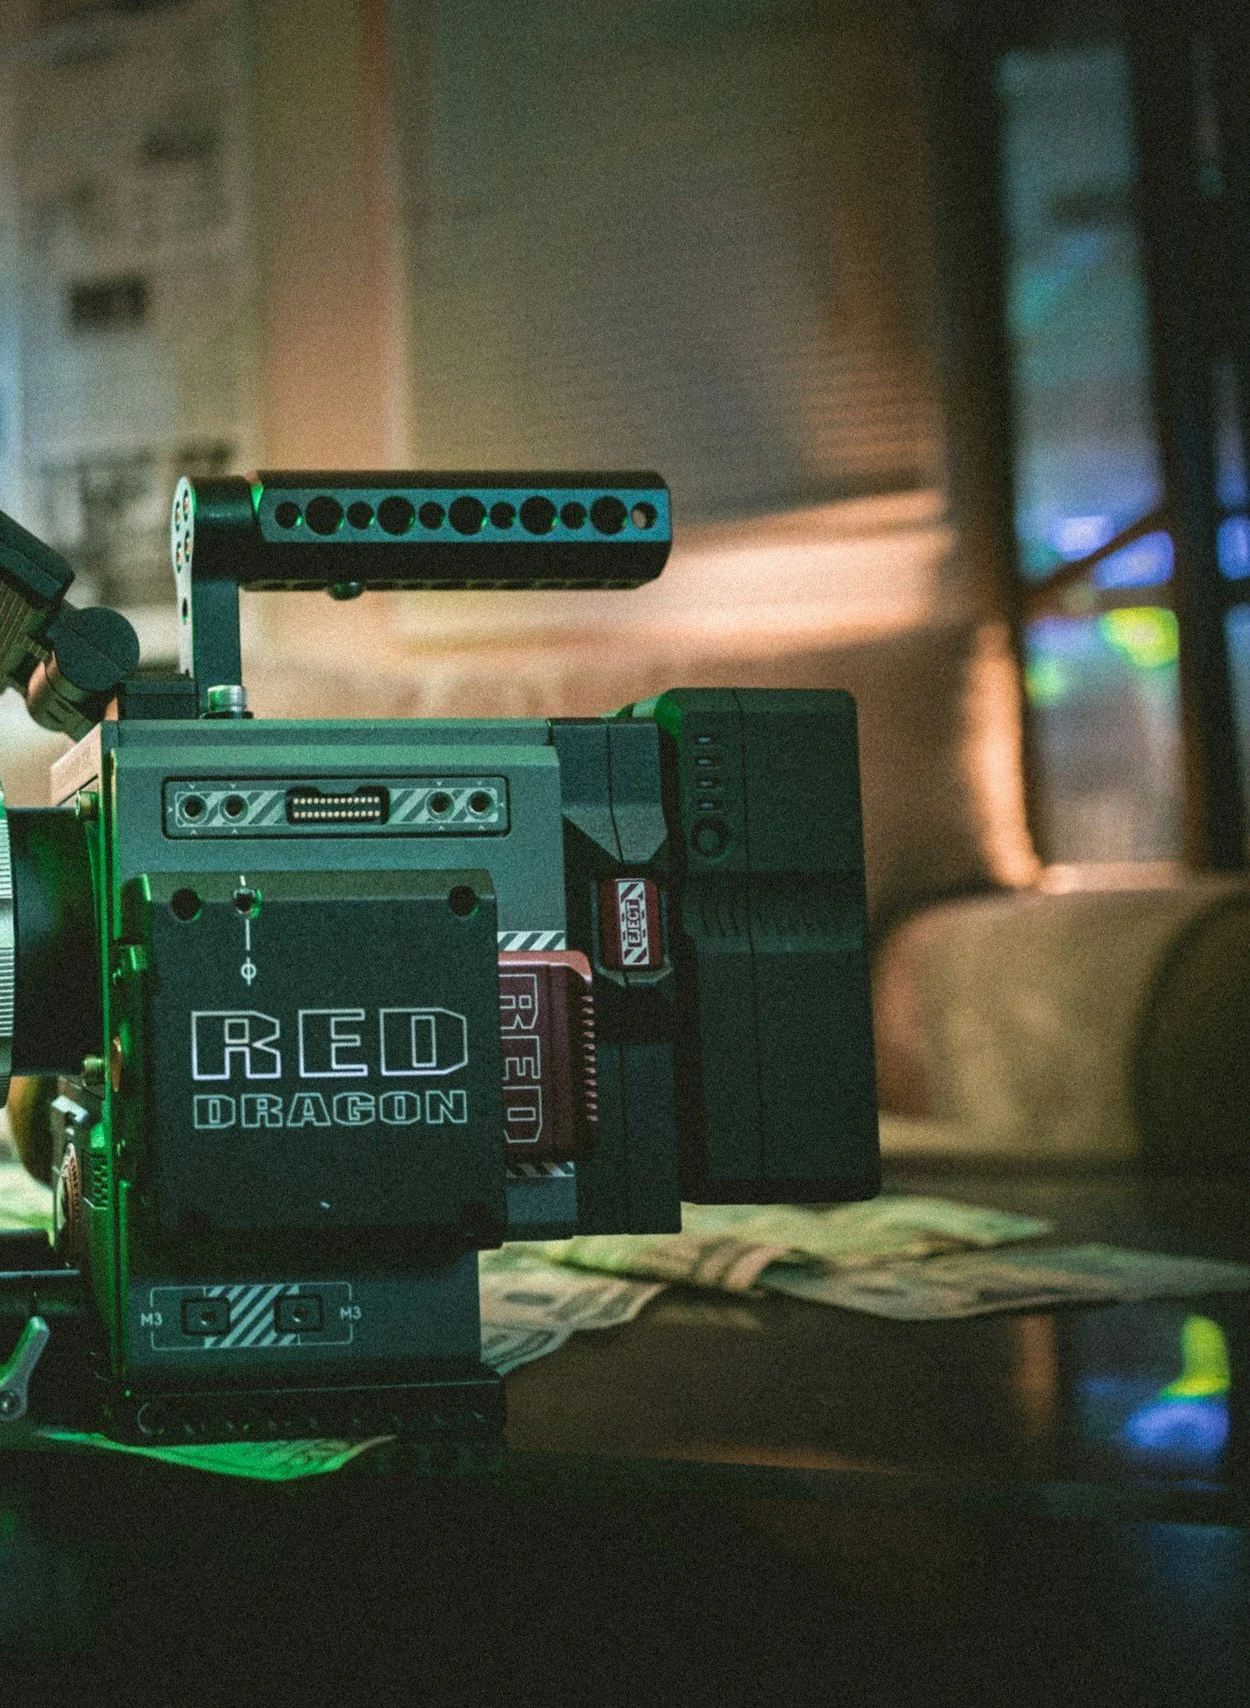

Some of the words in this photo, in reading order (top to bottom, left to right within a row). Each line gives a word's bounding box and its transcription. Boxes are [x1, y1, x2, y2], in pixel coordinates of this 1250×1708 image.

[626, 902, 641, 943] EJECT
[191, 1007, 468, 1080] RED
[500, 974, 543, 1143] RED
[192, 1090, 468, 1129] DRAGON
[140, 1312, 163, 1327] M3
[339, 1306, 362, 1320] M3
